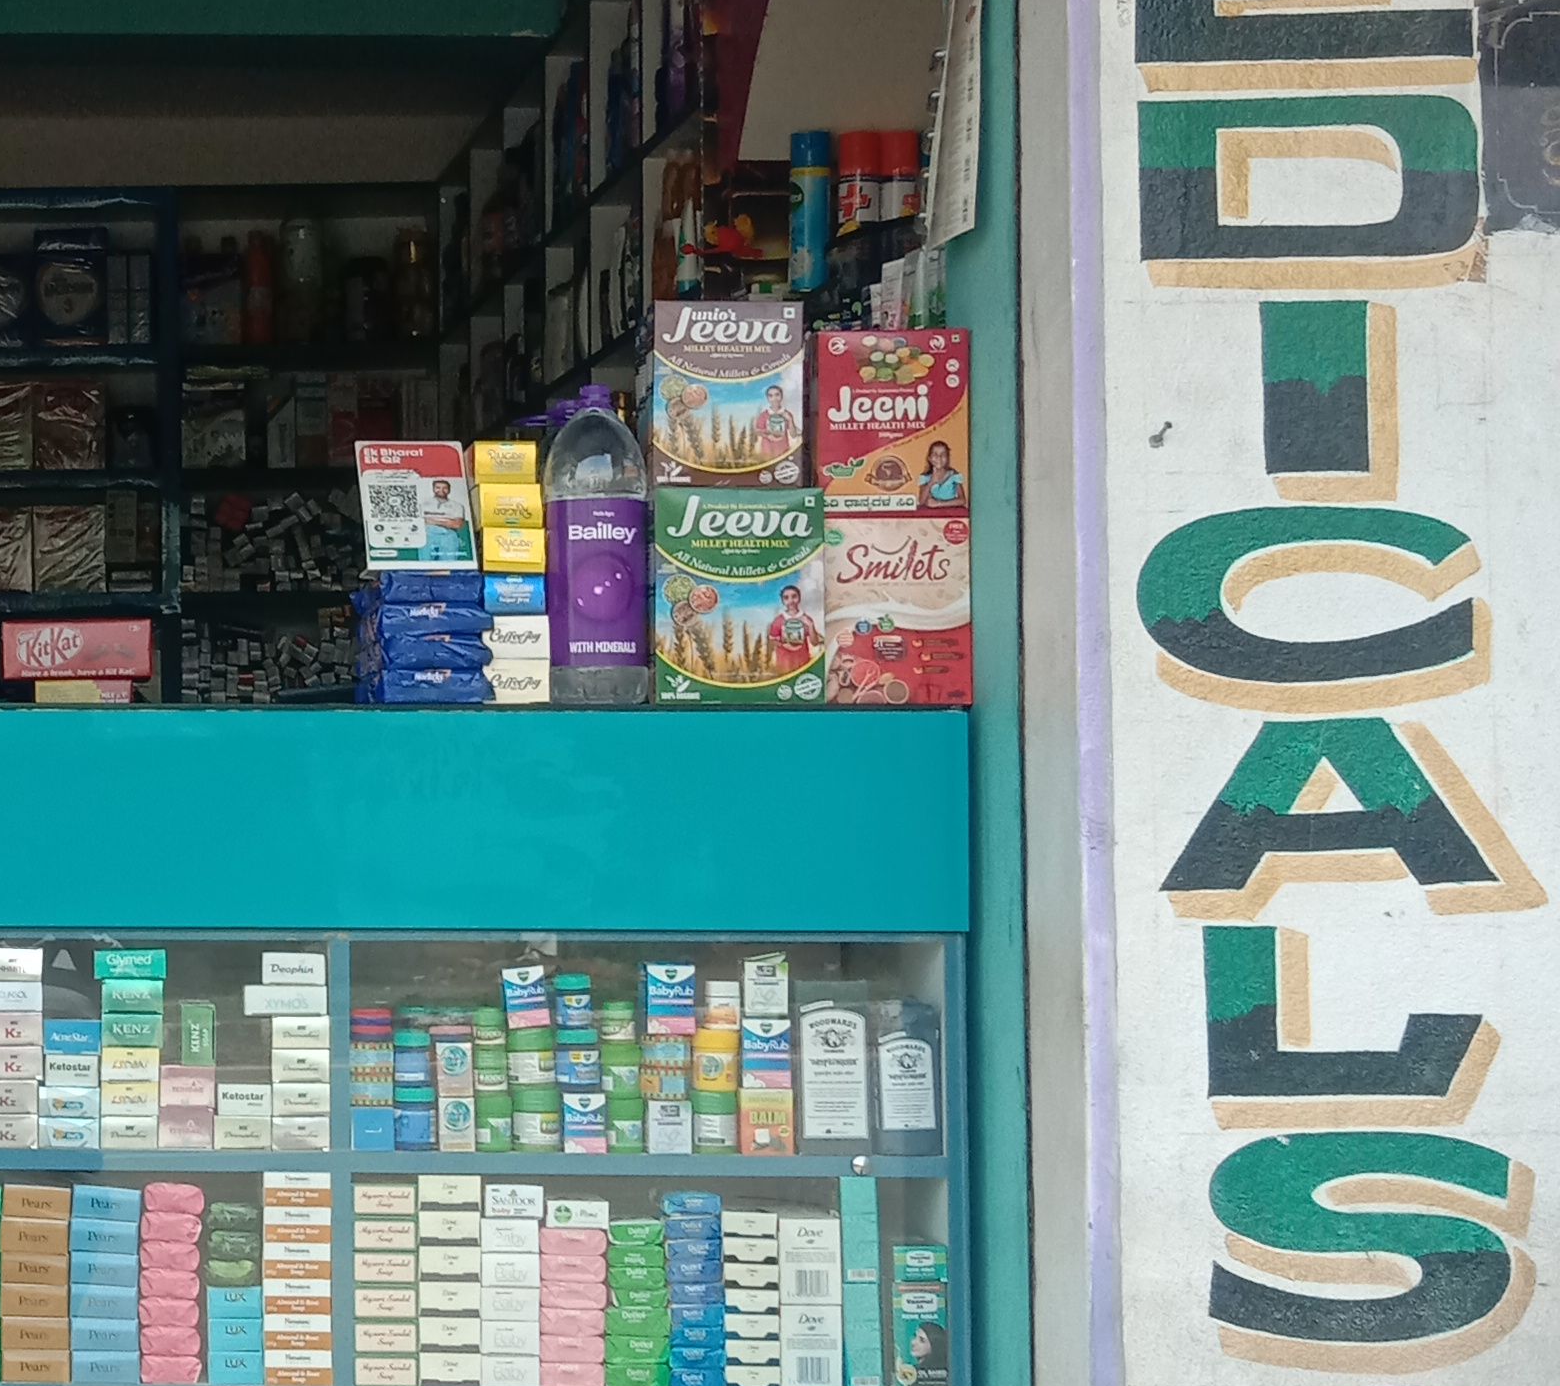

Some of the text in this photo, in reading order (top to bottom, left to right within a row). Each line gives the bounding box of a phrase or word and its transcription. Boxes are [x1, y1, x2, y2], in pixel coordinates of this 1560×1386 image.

[662, 307, 792, 344] Jeeva
[827, 384, 929, 422] Jeeni
[380, 447, 424, 457] Bharat
[666, 495, 813, 538] Jeeva
[568, 522, 636, 544] Bailley
[16, 627, 82, 670] KitKat
[569, 641, 636, 653] WITH MINERALS
[49, 1062, 91, 1072] Ketostar
[221, 1091, 264, 1102] Ketostar
[796, 1226, 824, 1238] Dove
[798, 1313, 825, 1325] Dove
